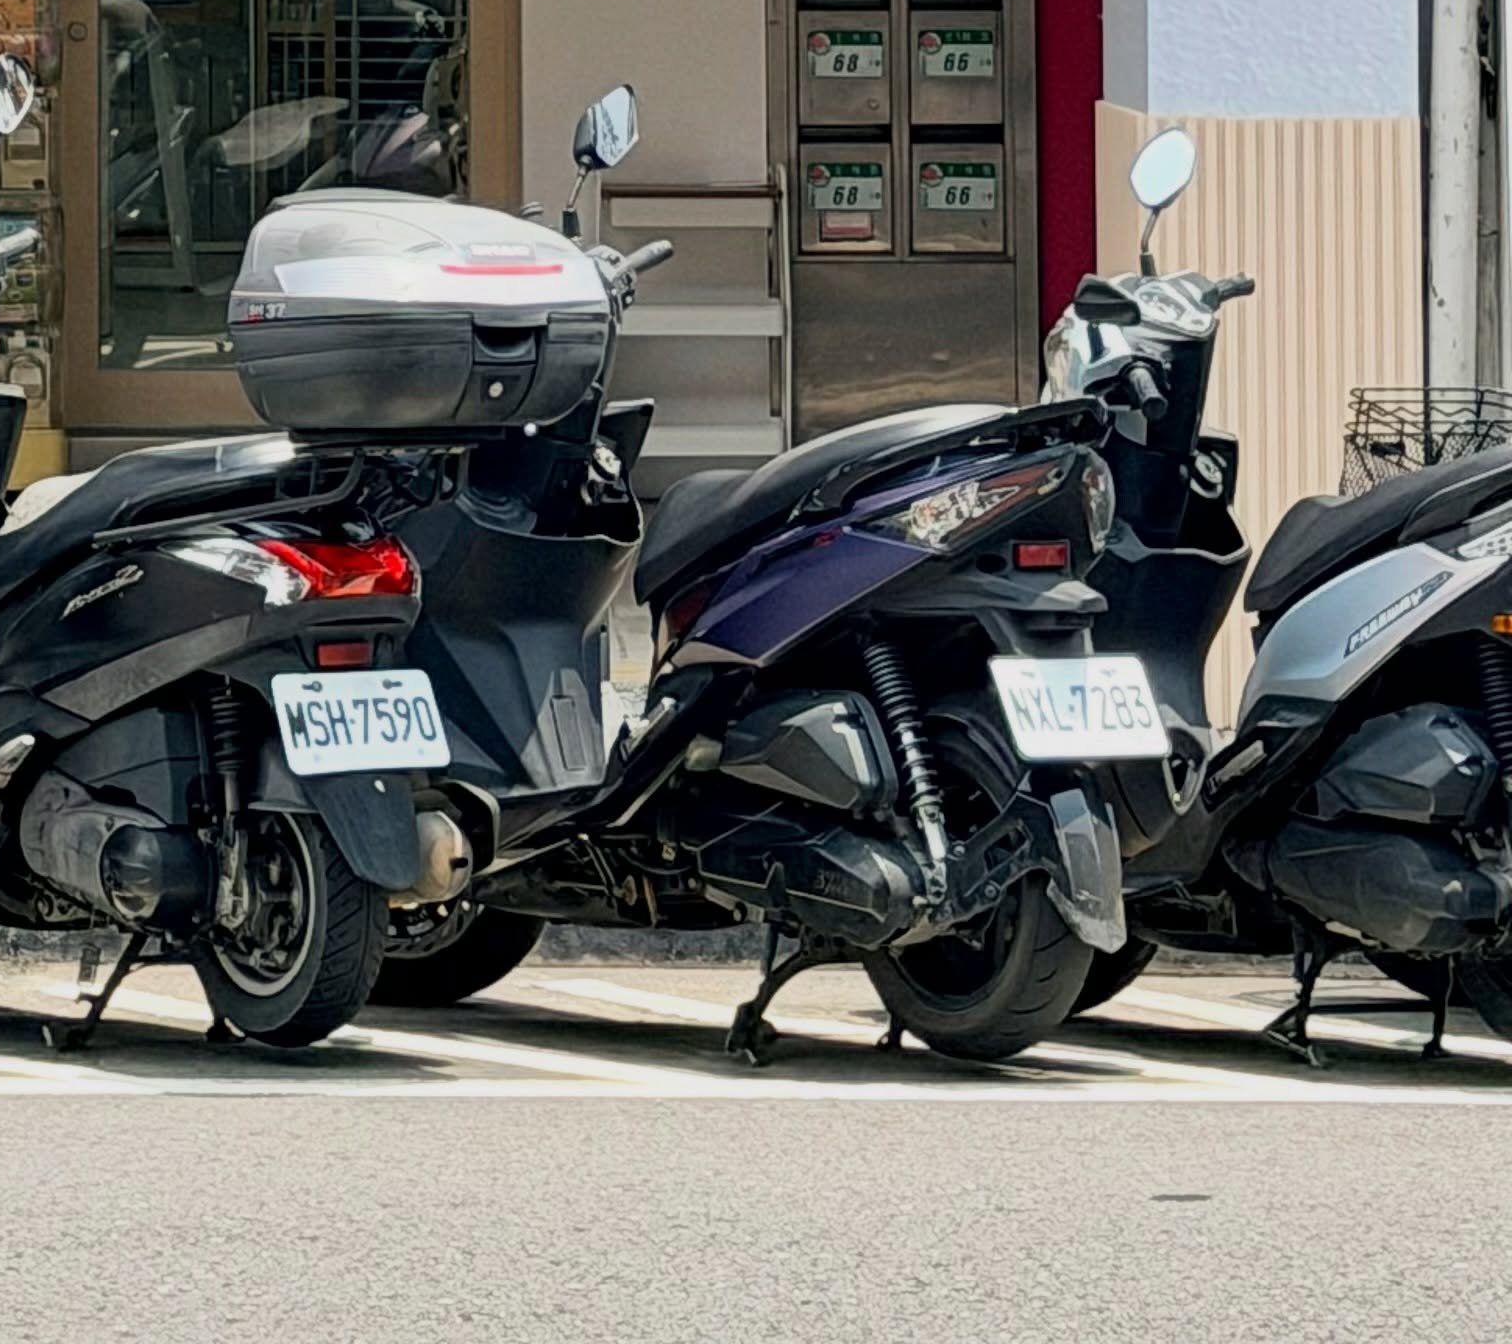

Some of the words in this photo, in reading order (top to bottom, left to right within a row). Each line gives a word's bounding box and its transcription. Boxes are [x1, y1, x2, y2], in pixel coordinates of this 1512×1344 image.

[832, 53, 859, 72] 68
[943, 53, 970, 72] 66
[832, 185, 859, 205] 68
[945, 185, 971, 205] 66
[265, 302, 287, 319] 37
